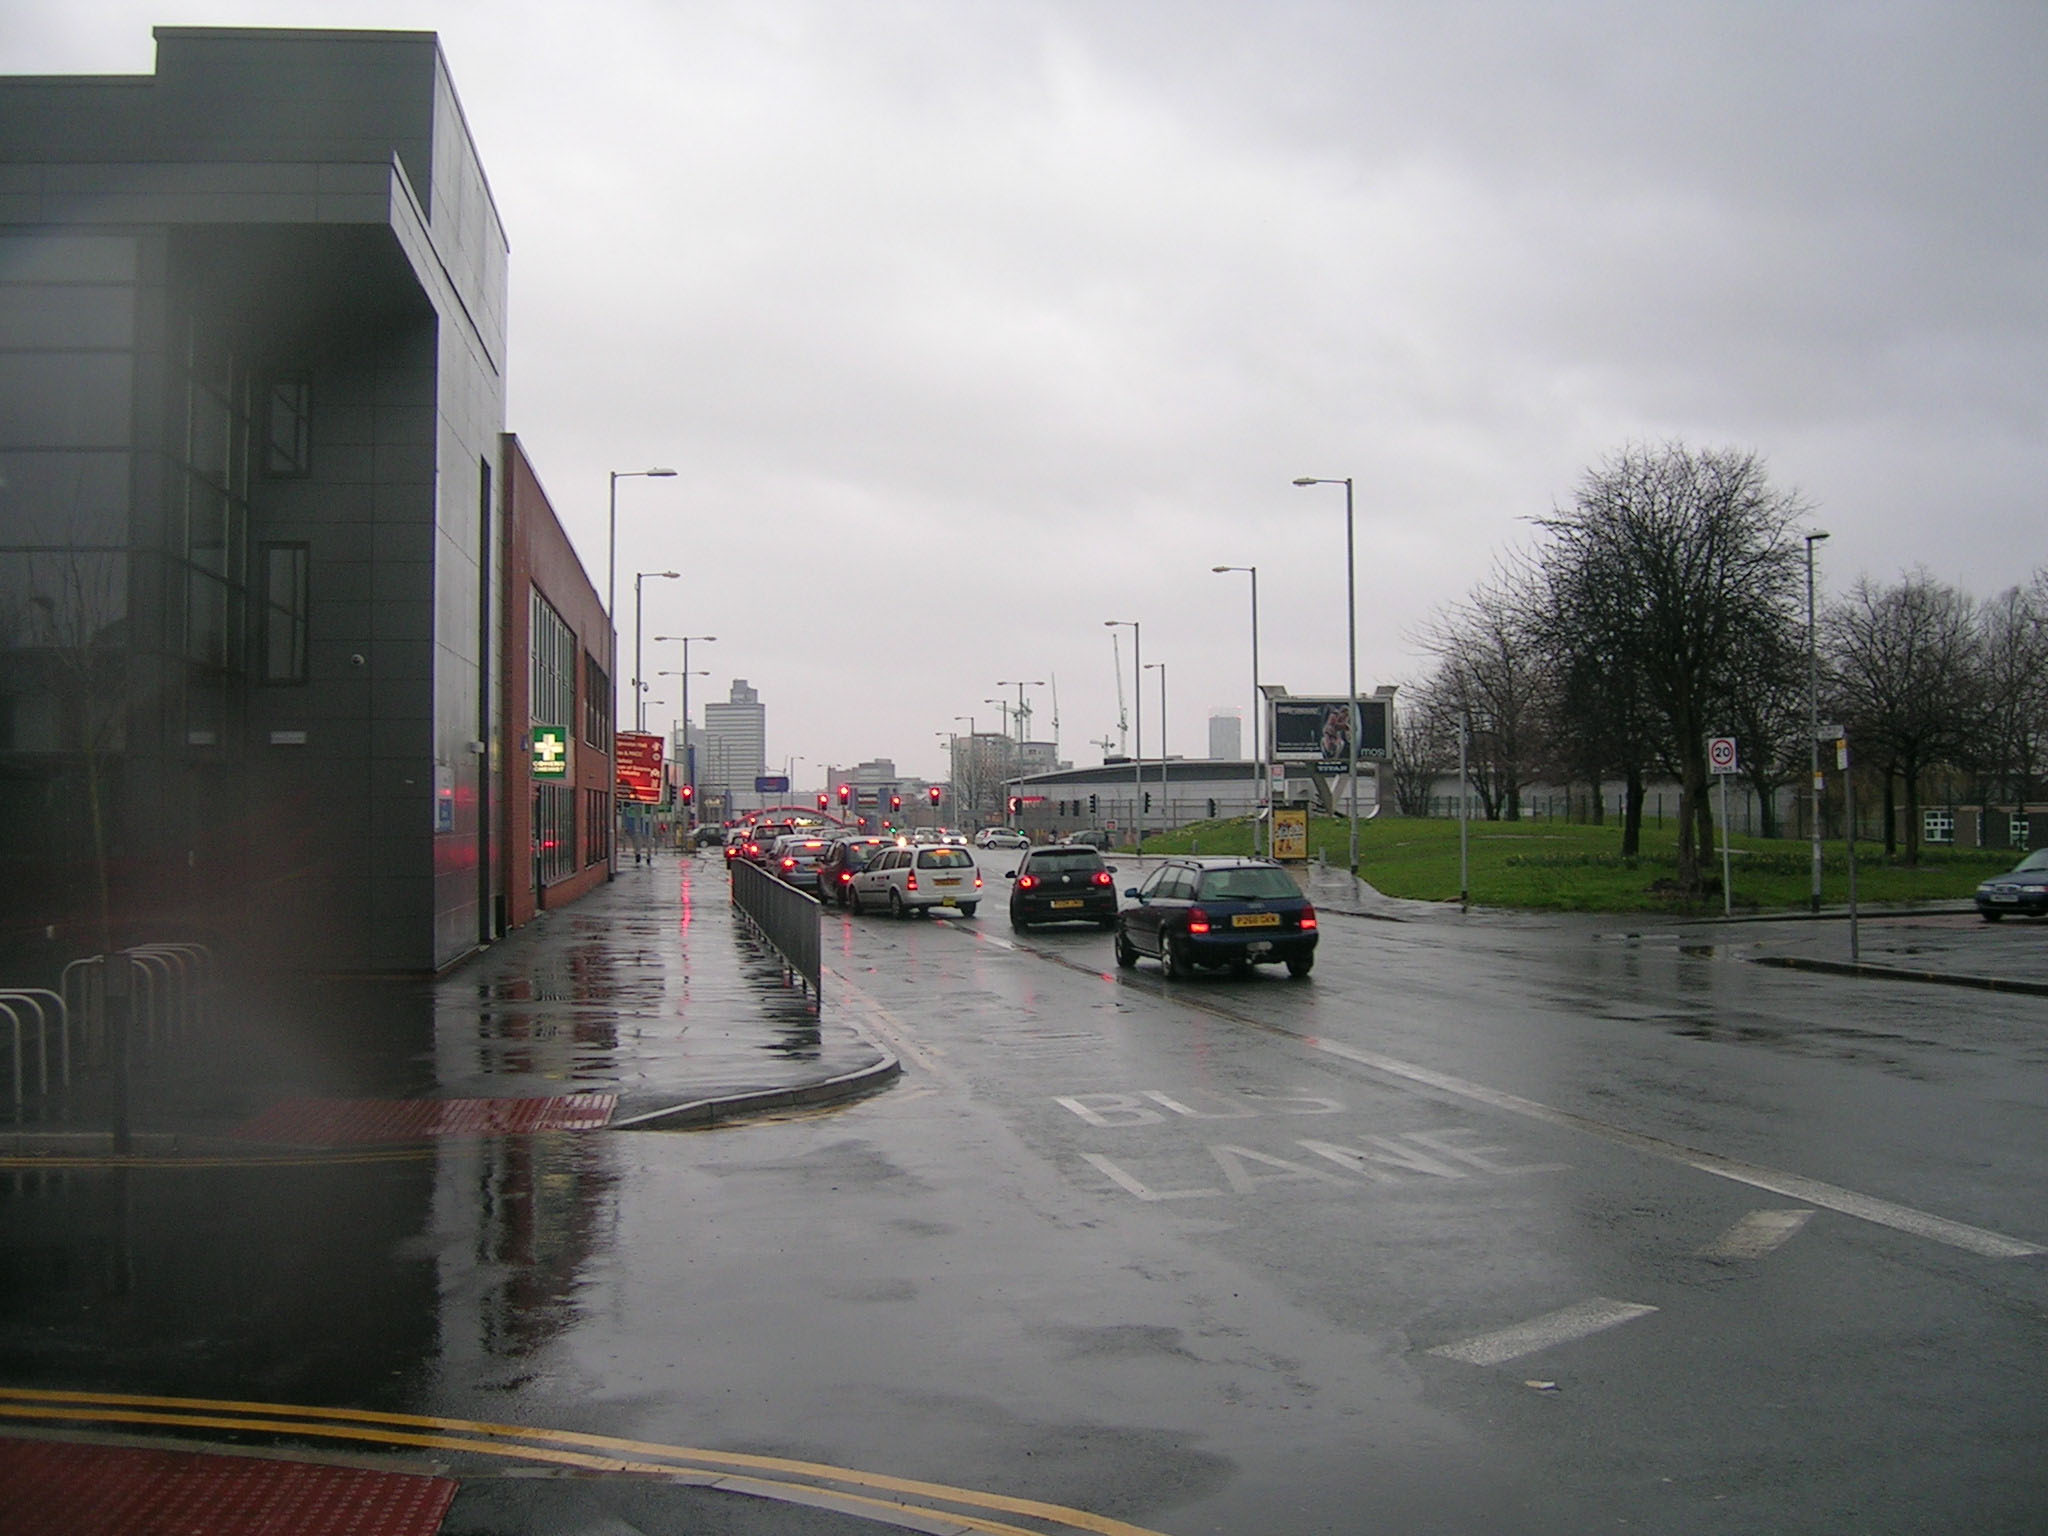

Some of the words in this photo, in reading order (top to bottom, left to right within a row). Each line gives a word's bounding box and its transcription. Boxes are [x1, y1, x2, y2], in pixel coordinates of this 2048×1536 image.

[1715, 746, 1730, 757] 20
[1056, 1090, 1346, 1128] BUS
[1080, 1128, 1574, 1200] LANE
